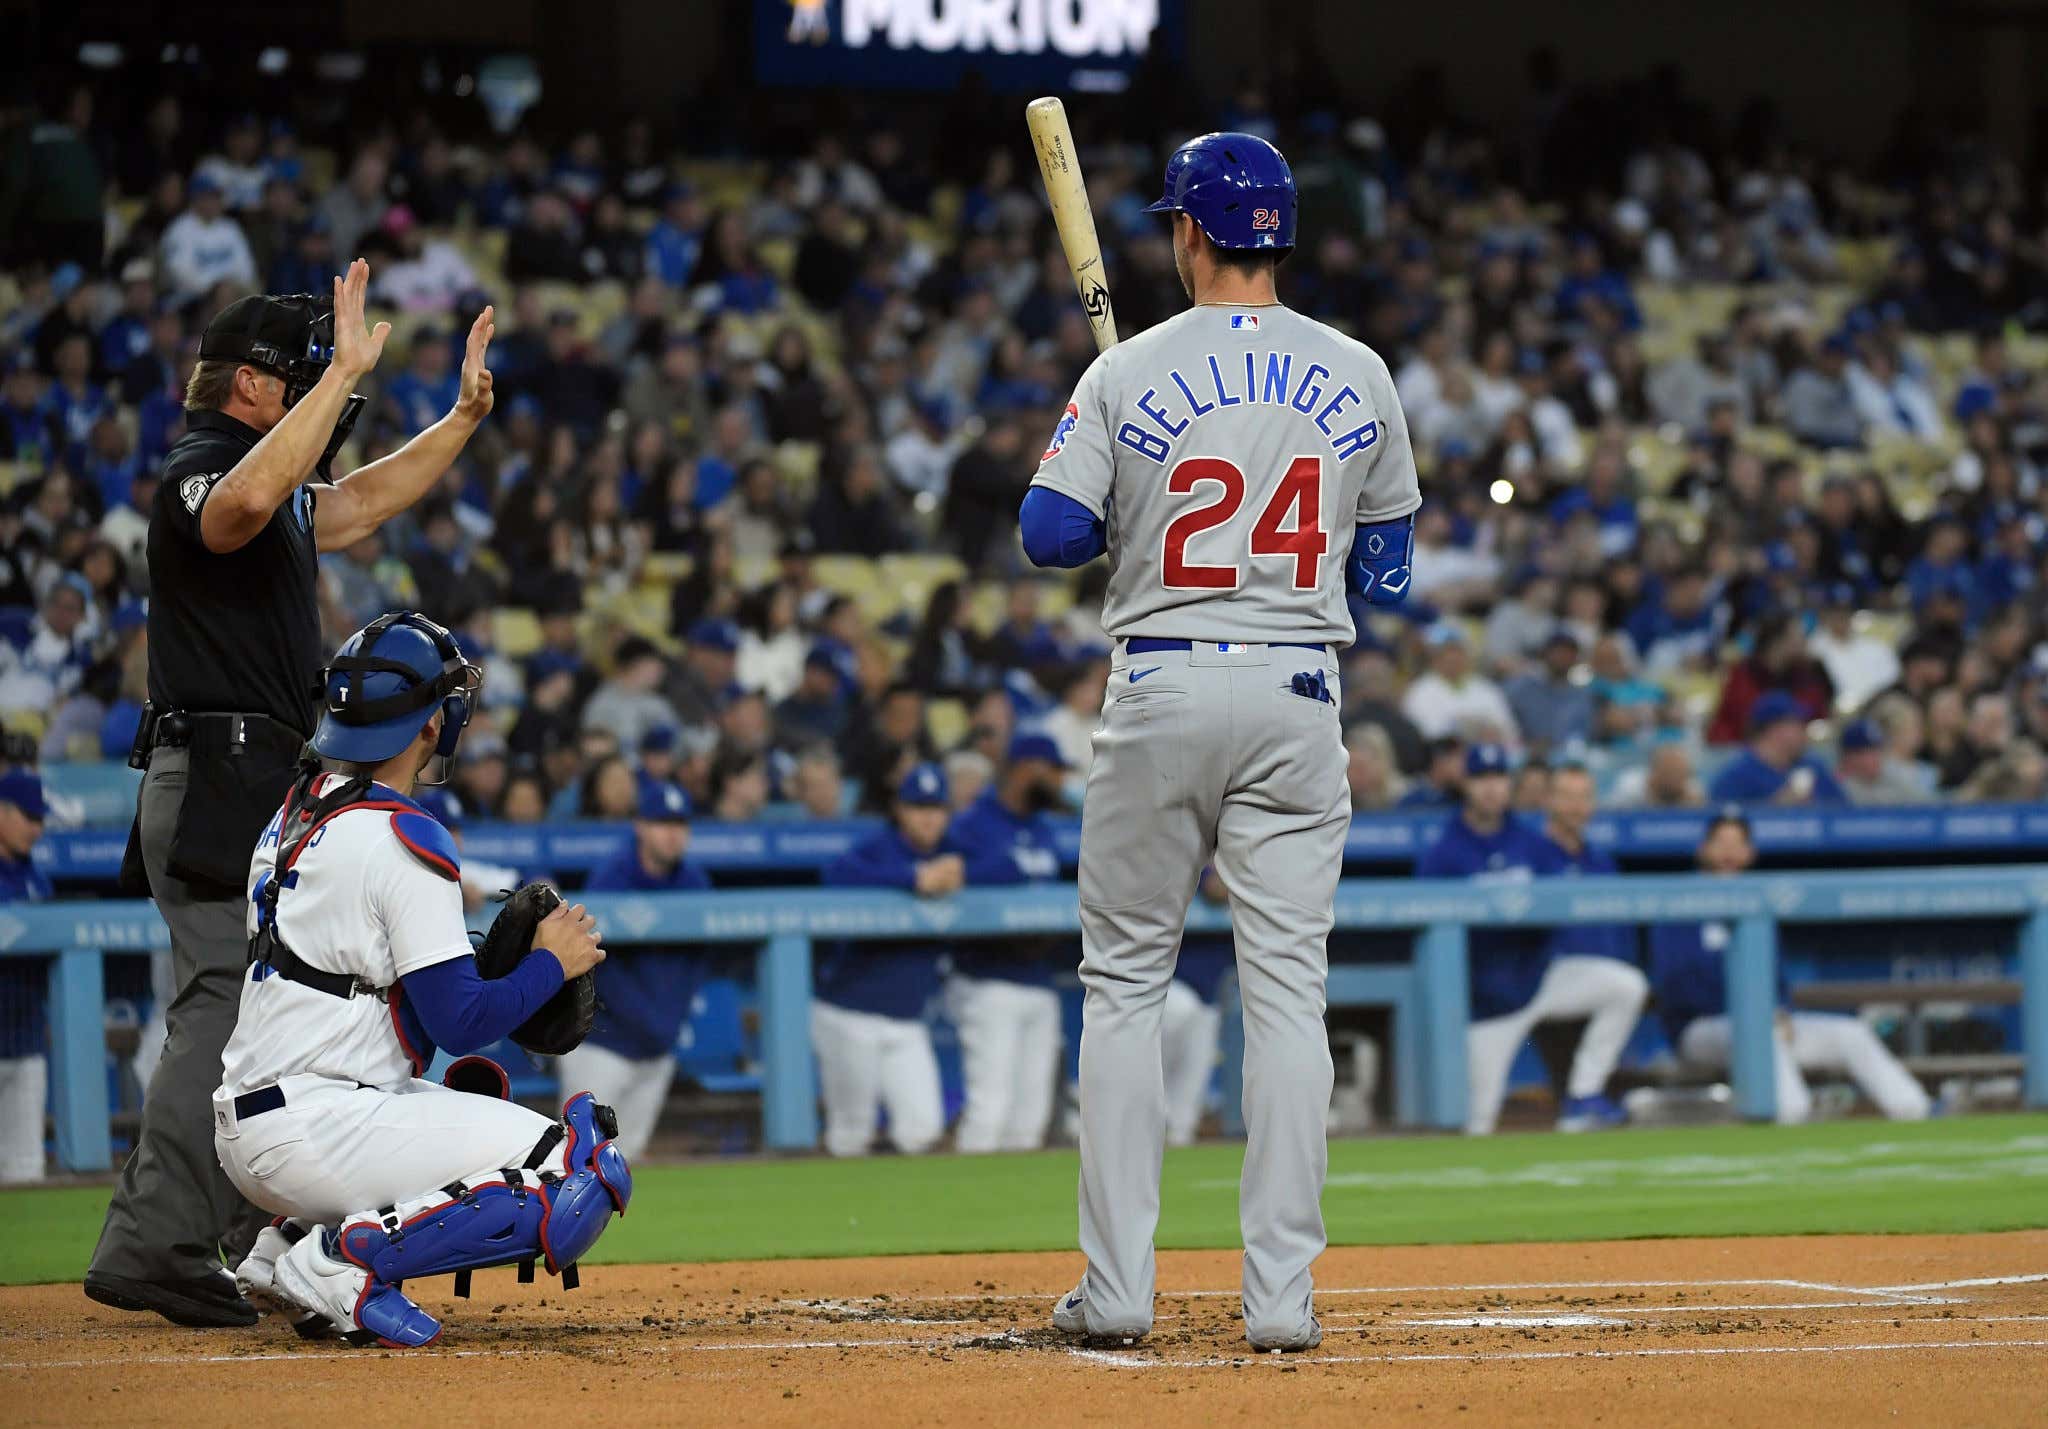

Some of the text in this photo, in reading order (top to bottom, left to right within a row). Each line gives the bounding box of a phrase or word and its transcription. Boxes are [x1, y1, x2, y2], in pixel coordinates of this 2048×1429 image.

[841, 0, 1160, 57] MORTON
[1253, 208, 1280, 230] 24
[1116, 352, 1380, 465] BELLINGER
[1162, 455, 1329, 591] 24
